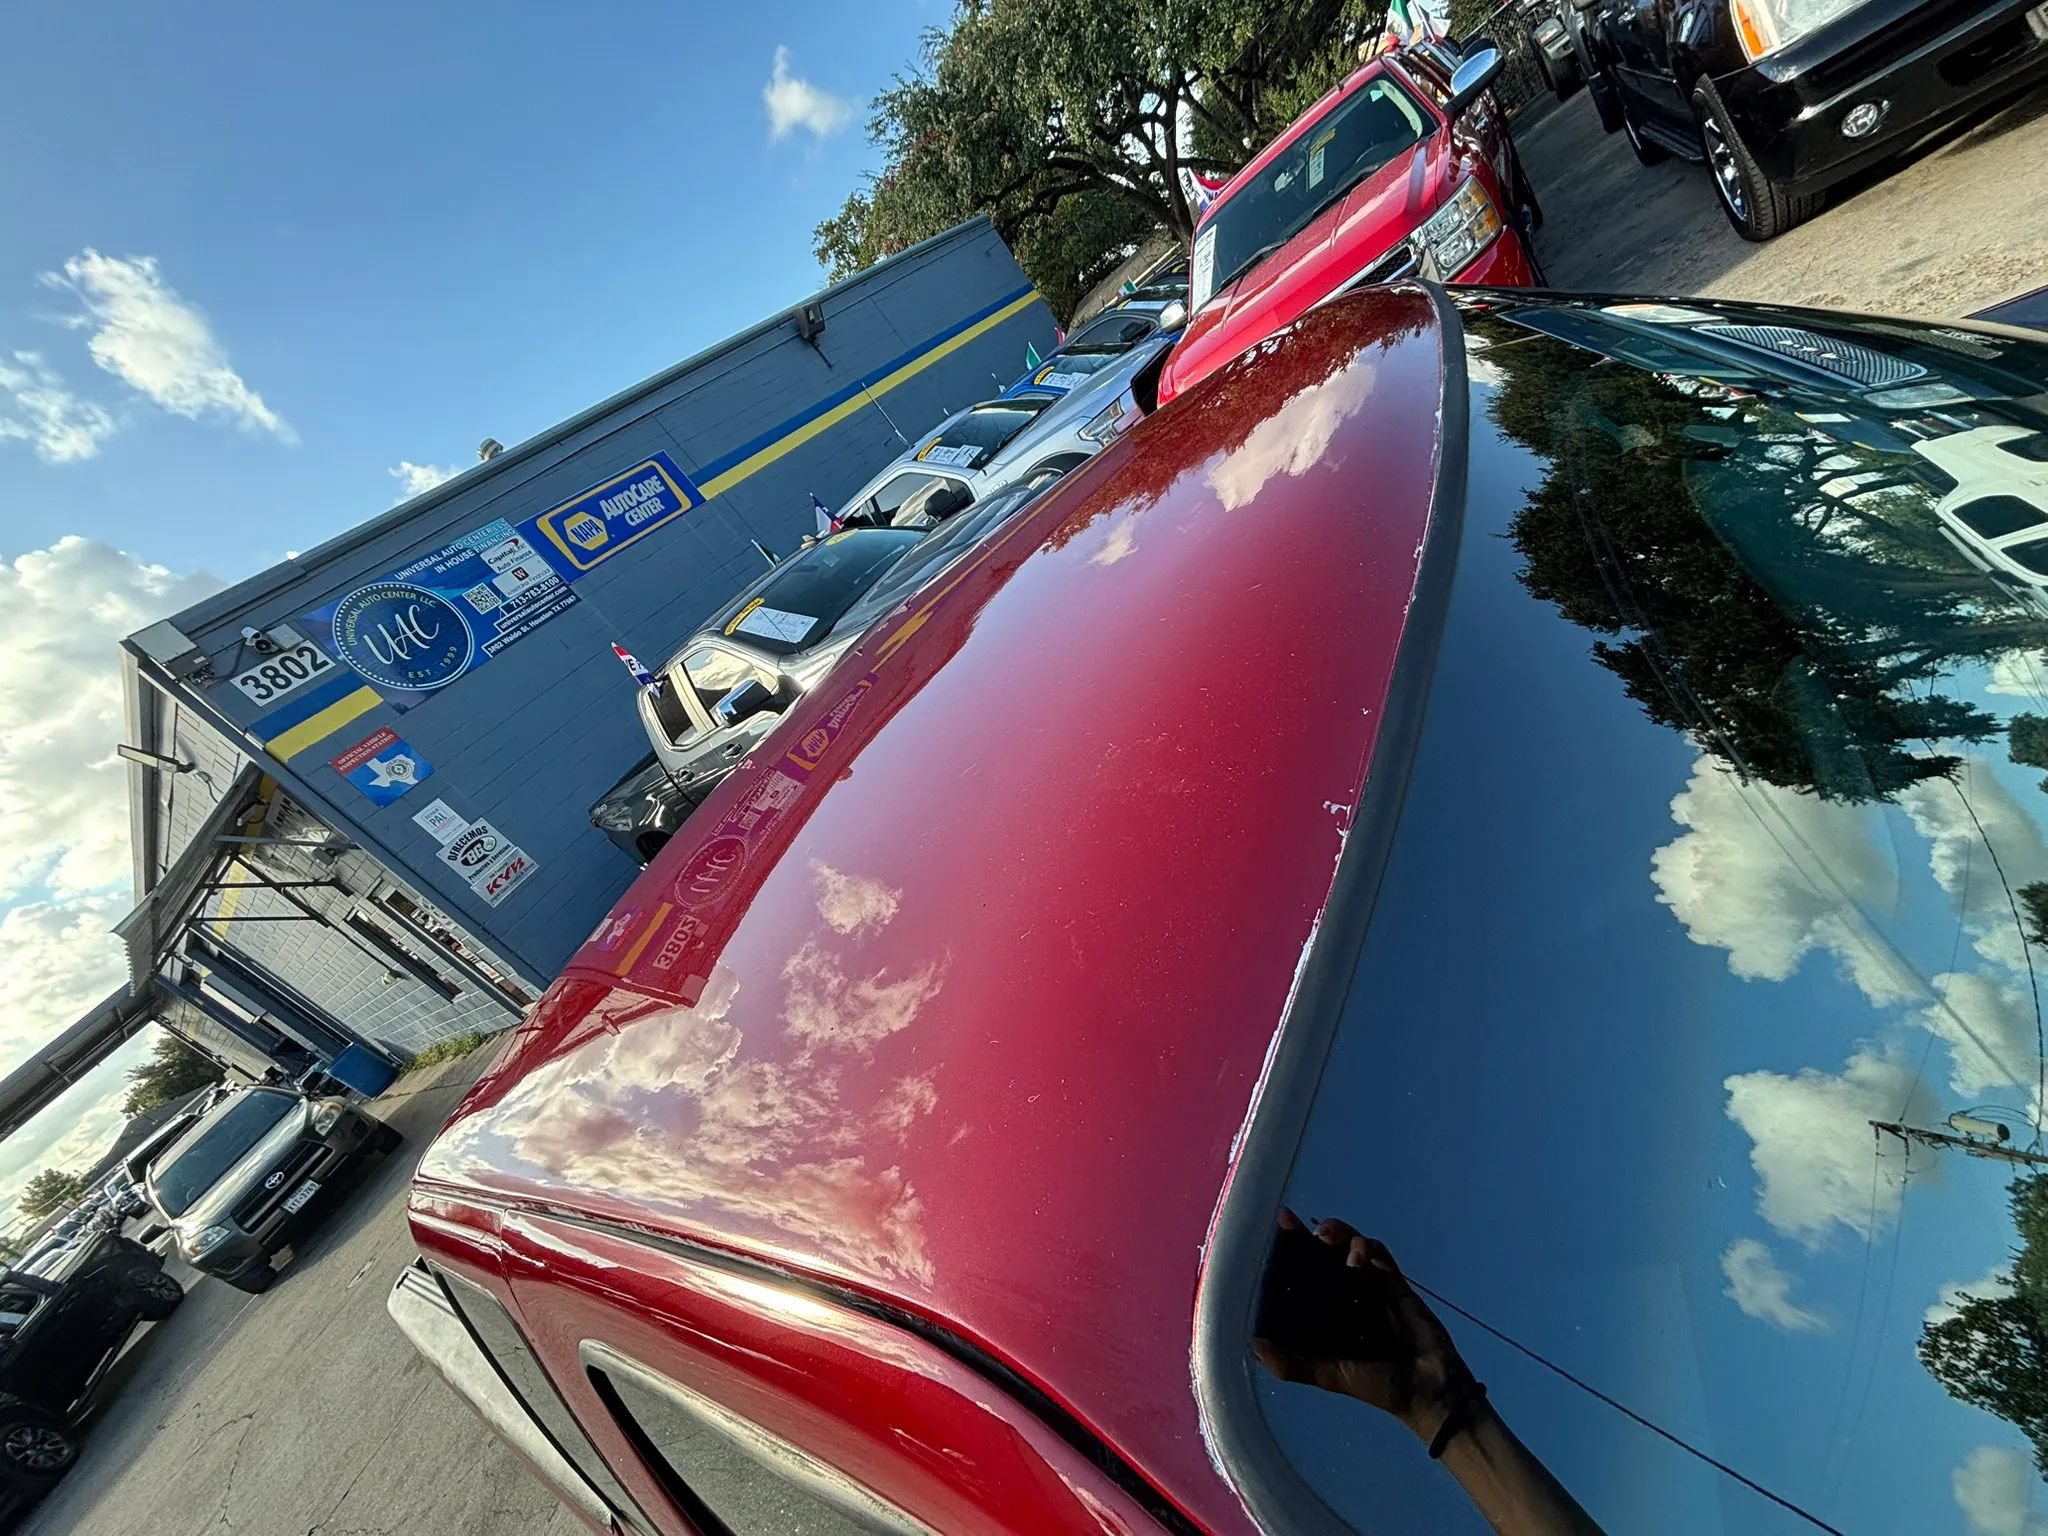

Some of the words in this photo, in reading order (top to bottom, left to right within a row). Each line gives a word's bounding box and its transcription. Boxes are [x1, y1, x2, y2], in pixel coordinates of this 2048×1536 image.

[599, 475, 665, 521] AUTOCARE
[624, 497, 665, 526] CENTER
[570, 518, 603, 544] NAPA
[394, 553, 444, 581] UNIVERSAL
[442, 542, 464, 557] AUTO
[463, 528, 493, 546] CENTER
[492, 519, 508, 533] LLC
[434, 564, 445, 574] IN
[445, 550, 476, 569] HOUSE
[473, 528, 516, 554] FINANCING
[487, 547, 515, 565] Capital
[510, 577, 560, 608] 713-783-8100
[345, 607, 363, 646] UNIVERSAL
[359, 594, 381, 609] AUTO
[382, 590, 417, 600] CENTER
[420, 596, 438, 608] LLC
[363, 604, 439, 665] UAC
[240, 646, 330, 700] 3802
[440, 646, 457, 668] 1999
[429, 813, 447, 827] PAL
[447, 826, 489, 861] OFRECEMOS
[486, 857, 525, 895] KYB
